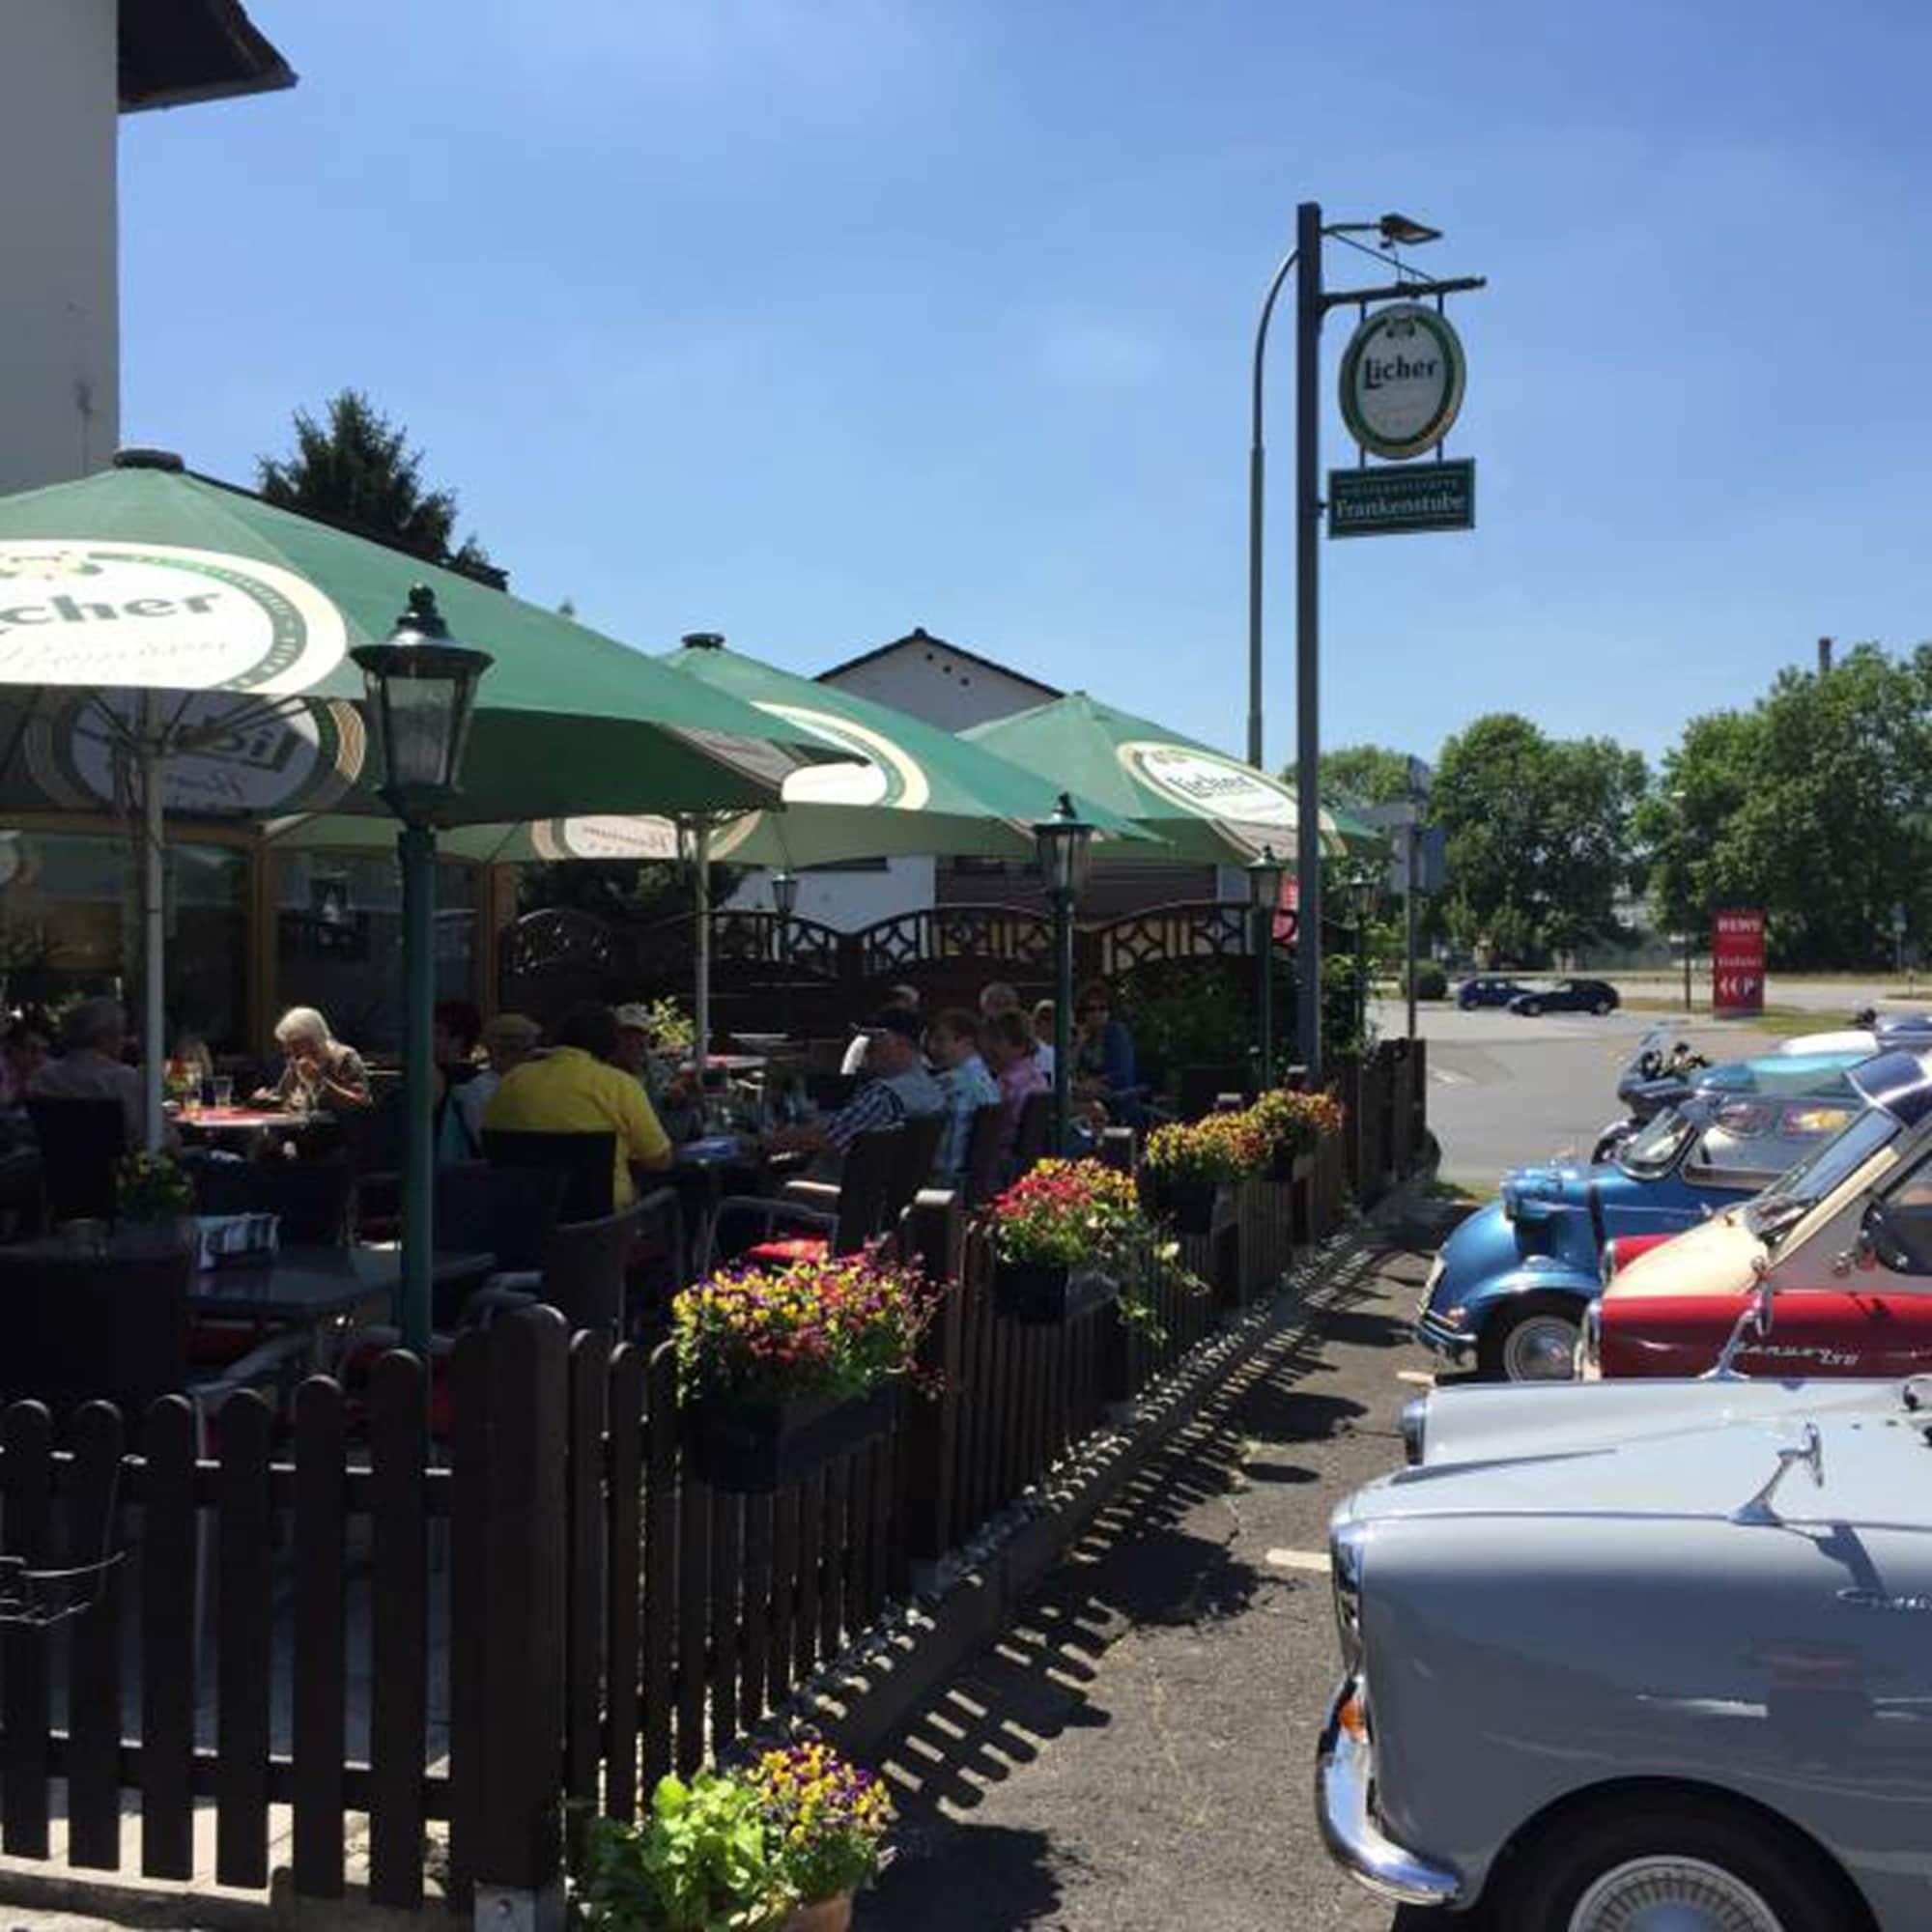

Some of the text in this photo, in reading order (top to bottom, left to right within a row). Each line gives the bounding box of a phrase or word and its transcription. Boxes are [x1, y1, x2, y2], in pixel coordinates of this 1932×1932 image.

[1364, 356, 1438, 389] Licher
[1336, 491, 1465, 519] Frankenstube
[0, 592, 221, 634] cher
